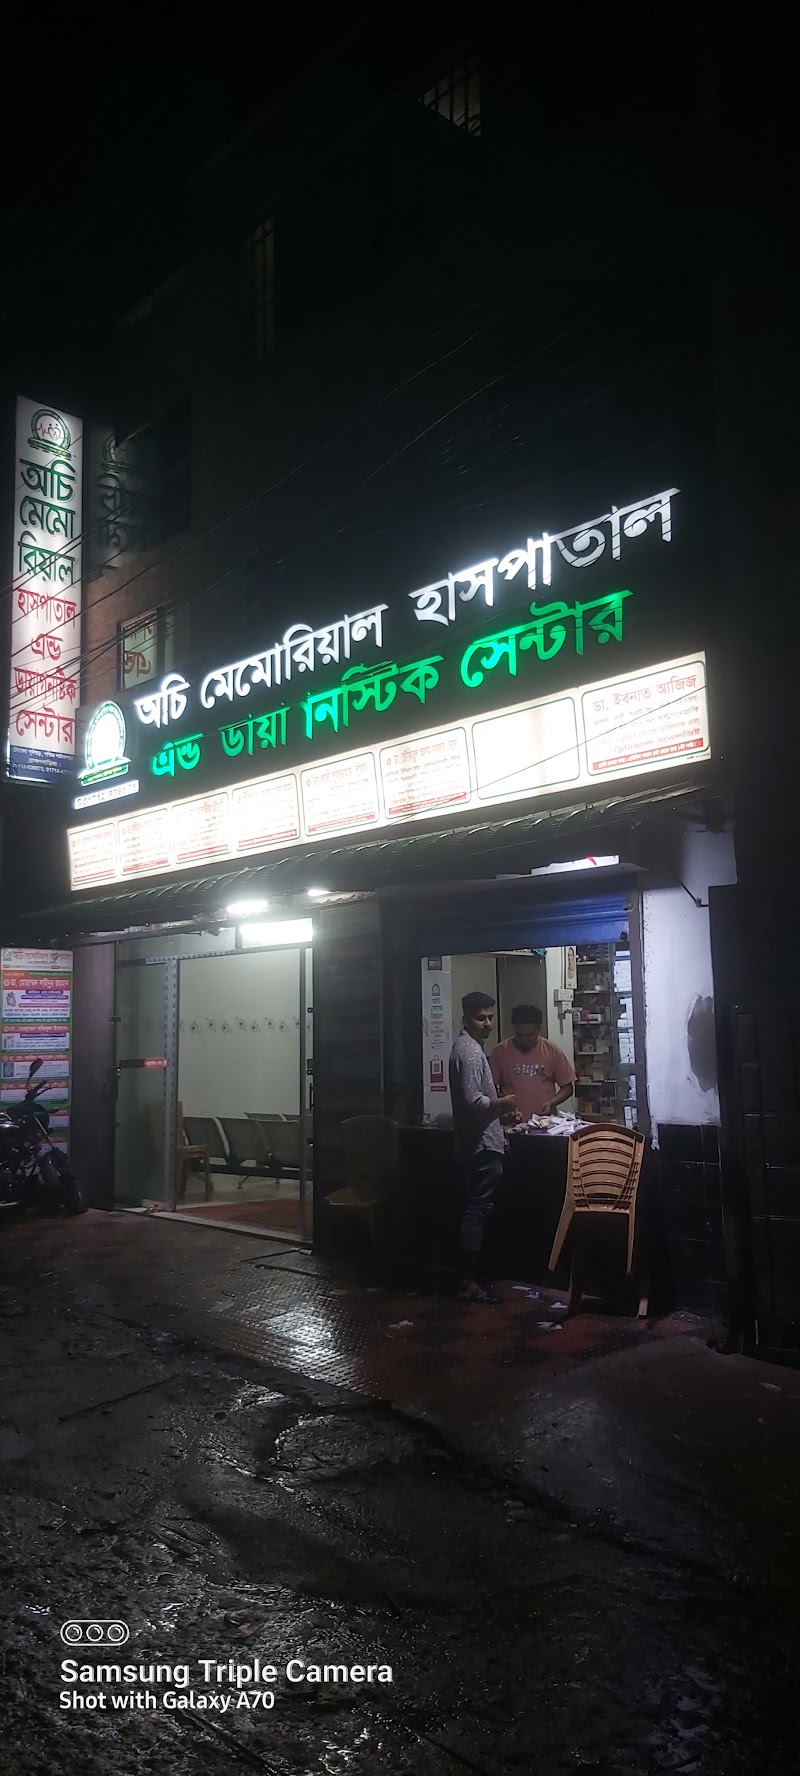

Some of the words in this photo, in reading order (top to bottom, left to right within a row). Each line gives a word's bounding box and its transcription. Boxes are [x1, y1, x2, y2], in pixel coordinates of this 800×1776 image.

[20, 459, 76, 501] অচি
[20, 496, 76, 539] মেমো
[18, 530, 76, 586] রিয়াল
[17, 589, 77, 629] হাসপাতাল
[134, 673, 190, 728] অচি
[201, 604, 389, 709] মেমোরিয়াল
[408, 487, 681, 626] হাসপাতাল
[152, 733, 204, 778] এন্ড
[461, 590, 633, 687] সেন্টার
[656, 675, 697, 695] আজিজ
[16, 702, 74, 744] সেন্টার
